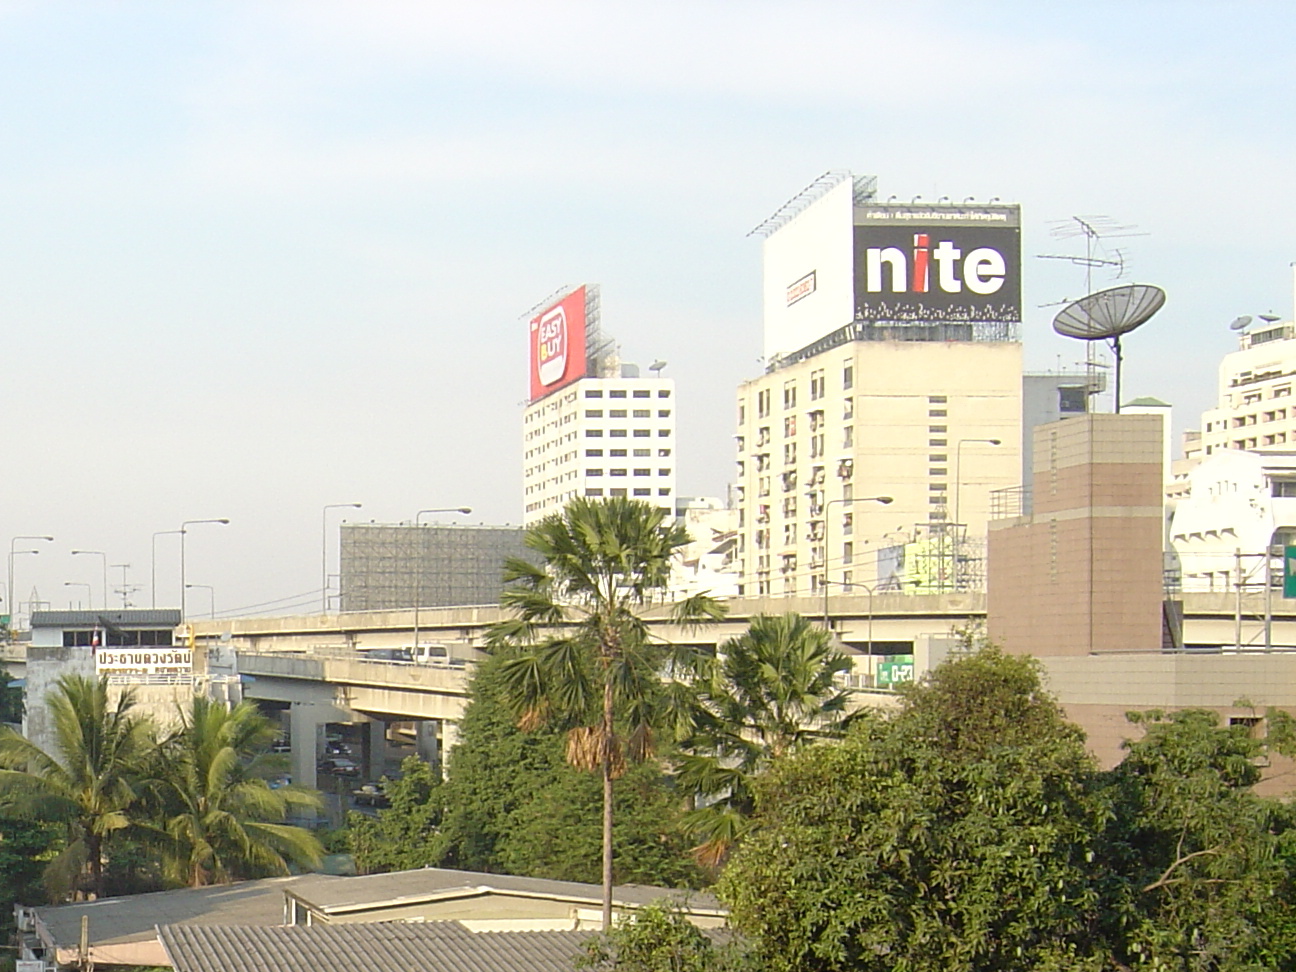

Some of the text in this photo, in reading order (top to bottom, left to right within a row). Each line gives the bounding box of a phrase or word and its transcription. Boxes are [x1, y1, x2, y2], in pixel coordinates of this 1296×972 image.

[867, 234, 1005, 294] nite
[541, 316, 562, 343] EASY
[540, 335, 562, 361] BUY
